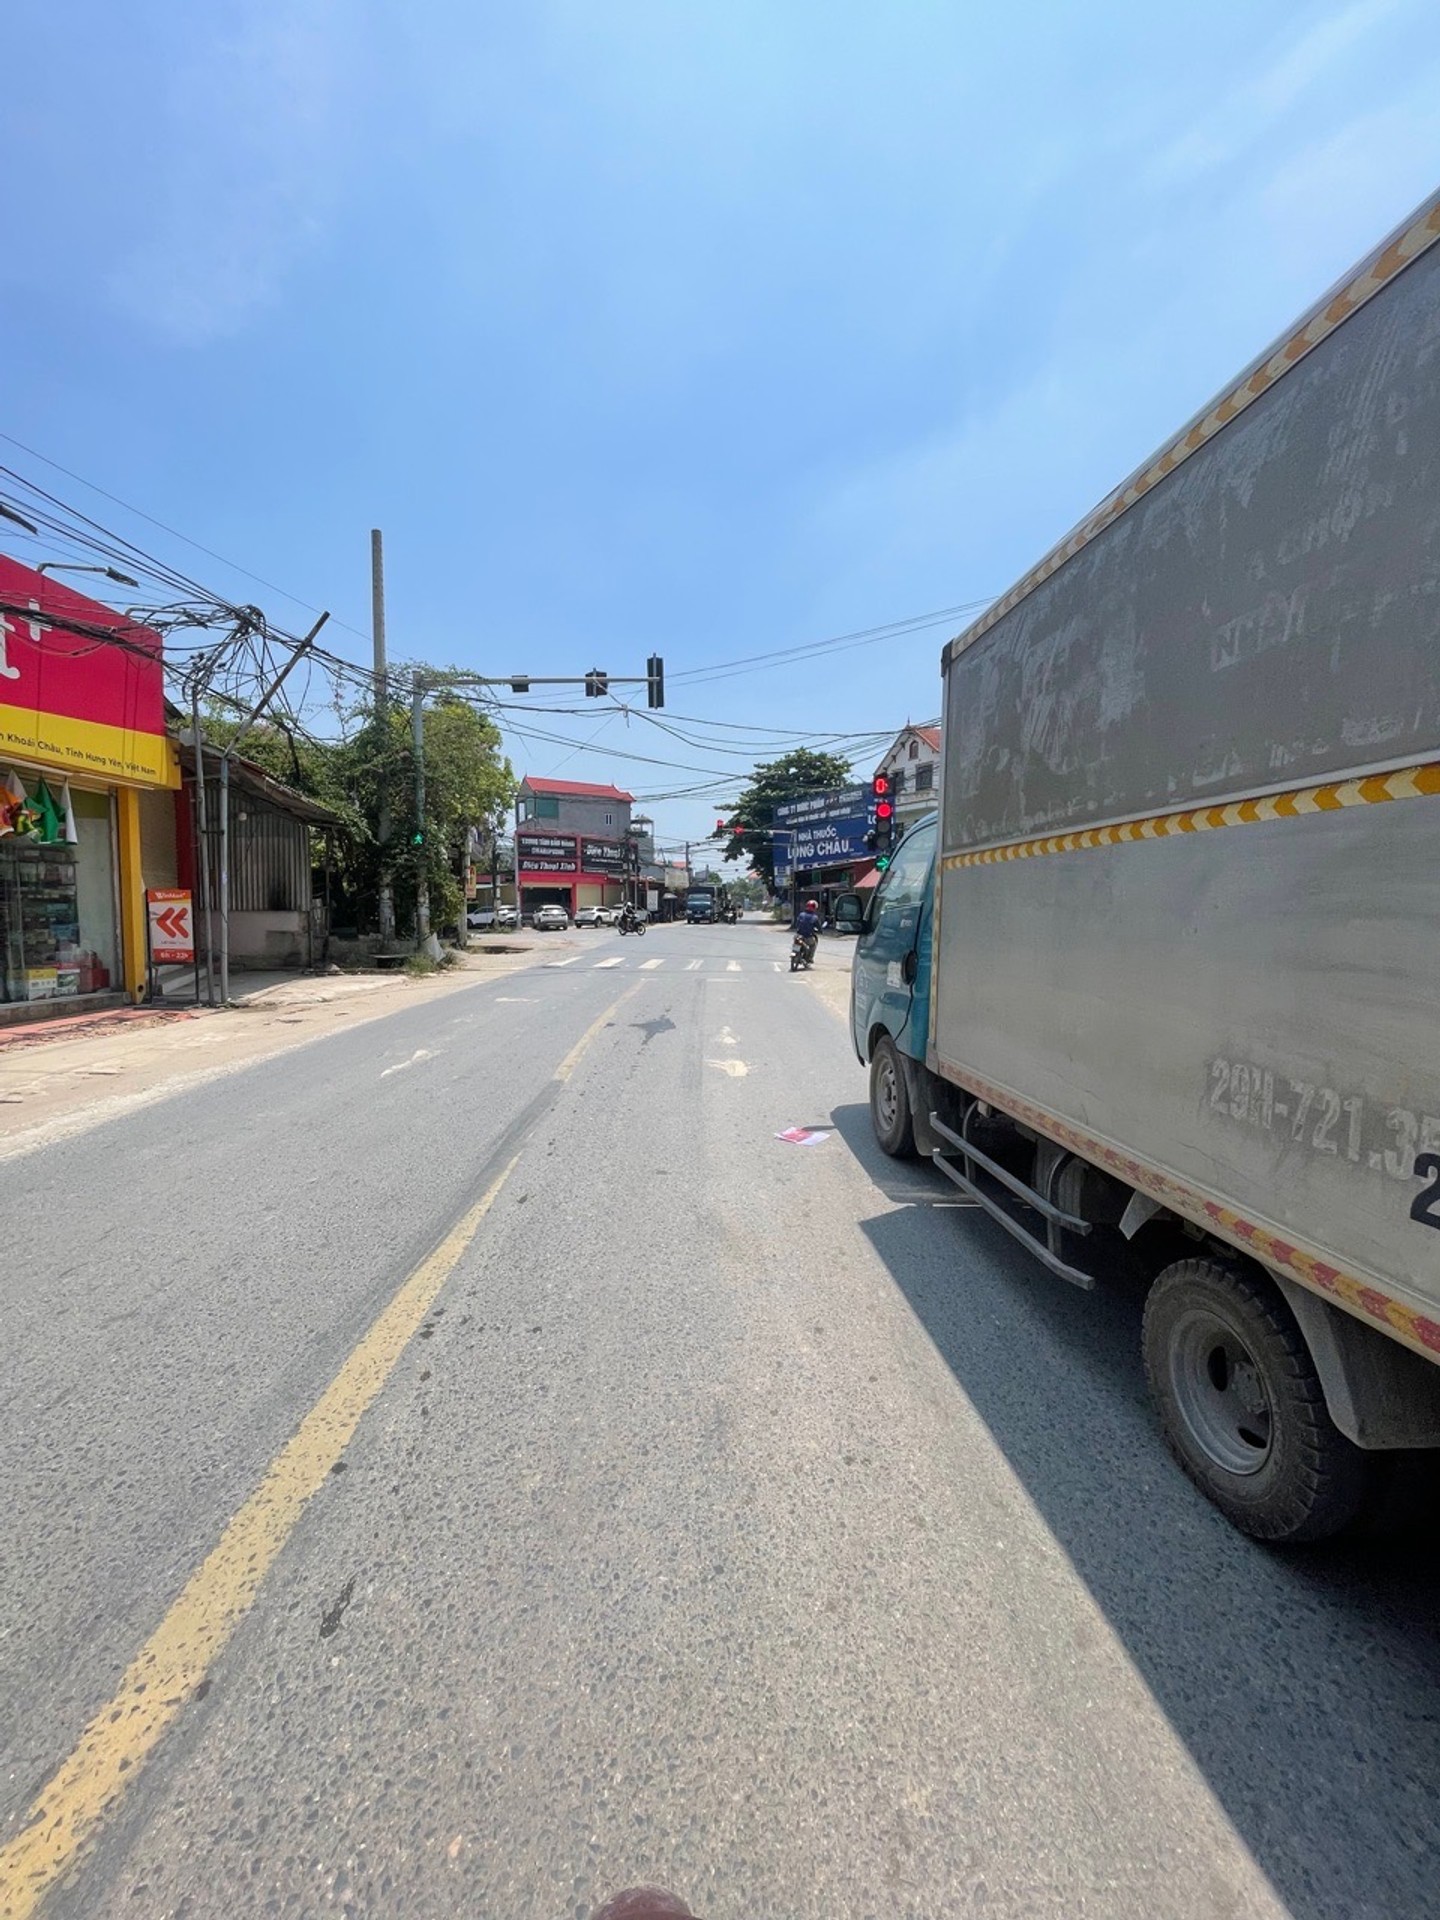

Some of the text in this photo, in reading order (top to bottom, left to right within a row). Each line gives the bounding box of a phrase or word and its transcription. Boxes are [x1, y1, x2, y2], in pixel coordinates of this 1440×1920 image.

[141, 765, 156, 775] Nam
[798, 824, 837, 842] NHÀ THUỐC
[787, 836, 849, 860] LONG CHÂU
